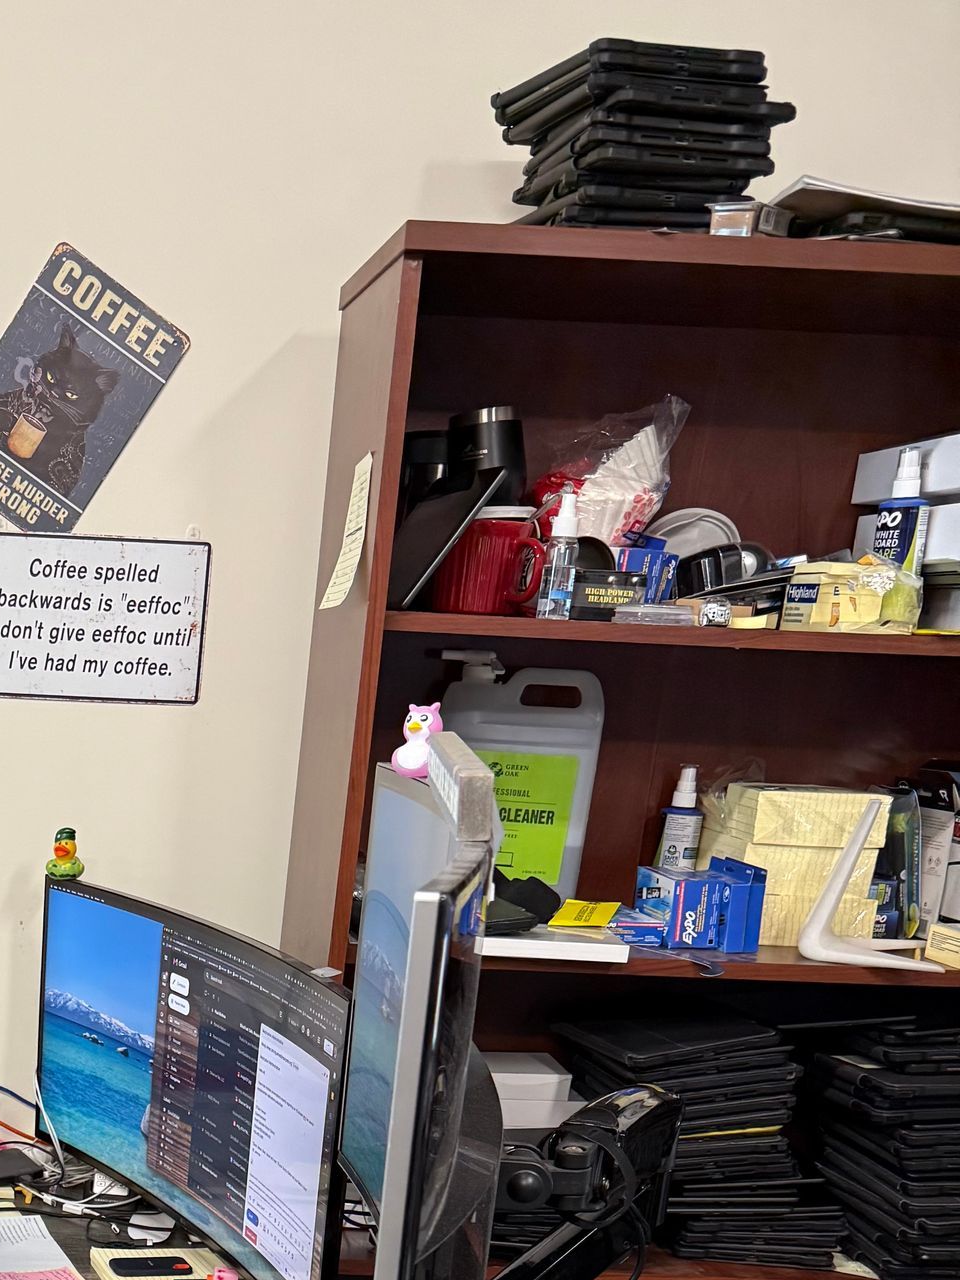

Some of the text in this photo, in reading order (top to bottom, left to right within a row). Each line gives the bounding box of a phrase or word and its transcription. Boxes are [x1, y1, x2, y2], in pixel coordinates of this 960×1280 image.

[52, 259, 176, 367] COFFEE
[13, 475, 69, 525] MURDER
[29, 557, 159, 587] Coffee spelled
[585, 587, 634, 598] HIGH POWER
[587, 595, 629, 604] HEADLAMP
[787, 585, 819, 601] Highland
[98, 593, 113, 612] is
[121, 593, 192, 616] "eeffoc".
[0, 620, 44, 639] don't
[49, 622, 85, 645] give
[92, 626, 147, 644] eeffoc
[153, 628, 193, 647] until
[8, 650, 172, 678] I've had my coffee.
[505, 763, 529, 771] GREEN
[499, 807, 555, 825] CLEANER
